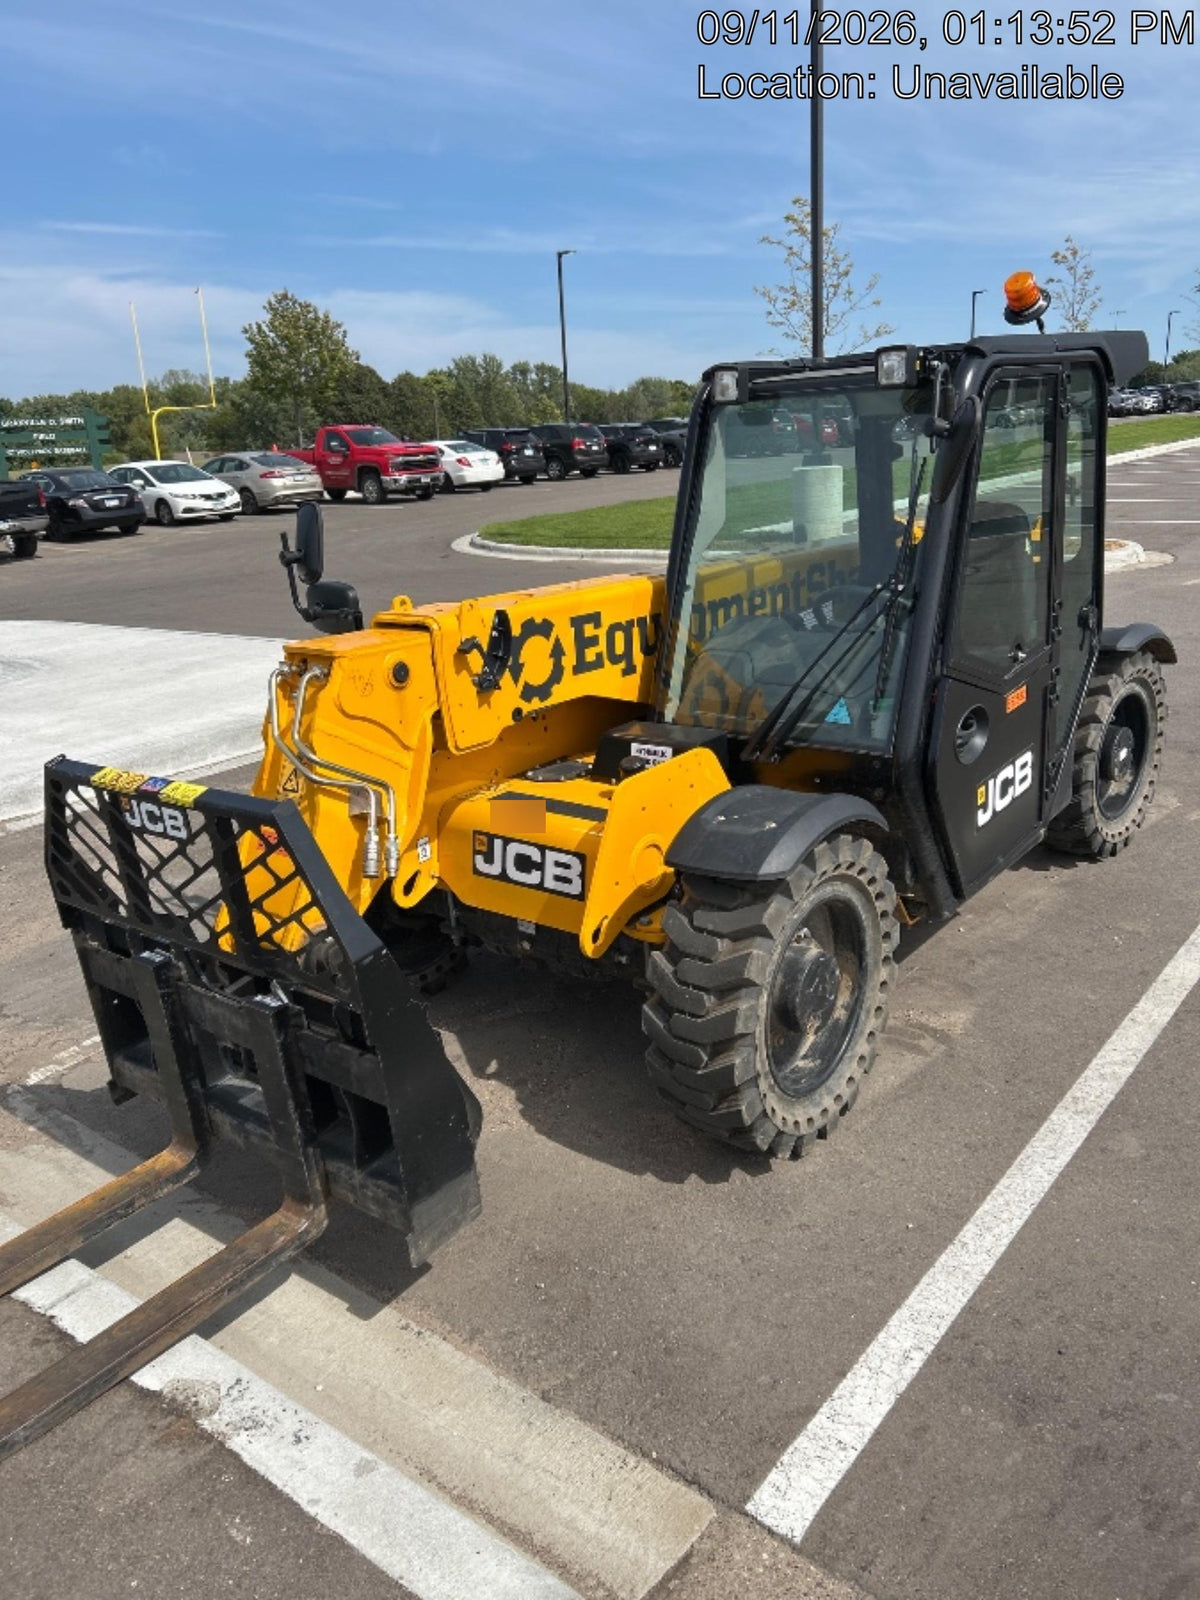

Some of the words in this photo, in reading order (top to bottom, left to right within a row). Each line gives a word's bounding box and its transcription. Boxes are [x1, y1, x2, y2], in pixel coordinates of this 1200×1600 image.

[977, 750, 1033, 828] JCB
[123, 799, 188, 840] JCB
[474, 837, 583, 896] JCB
